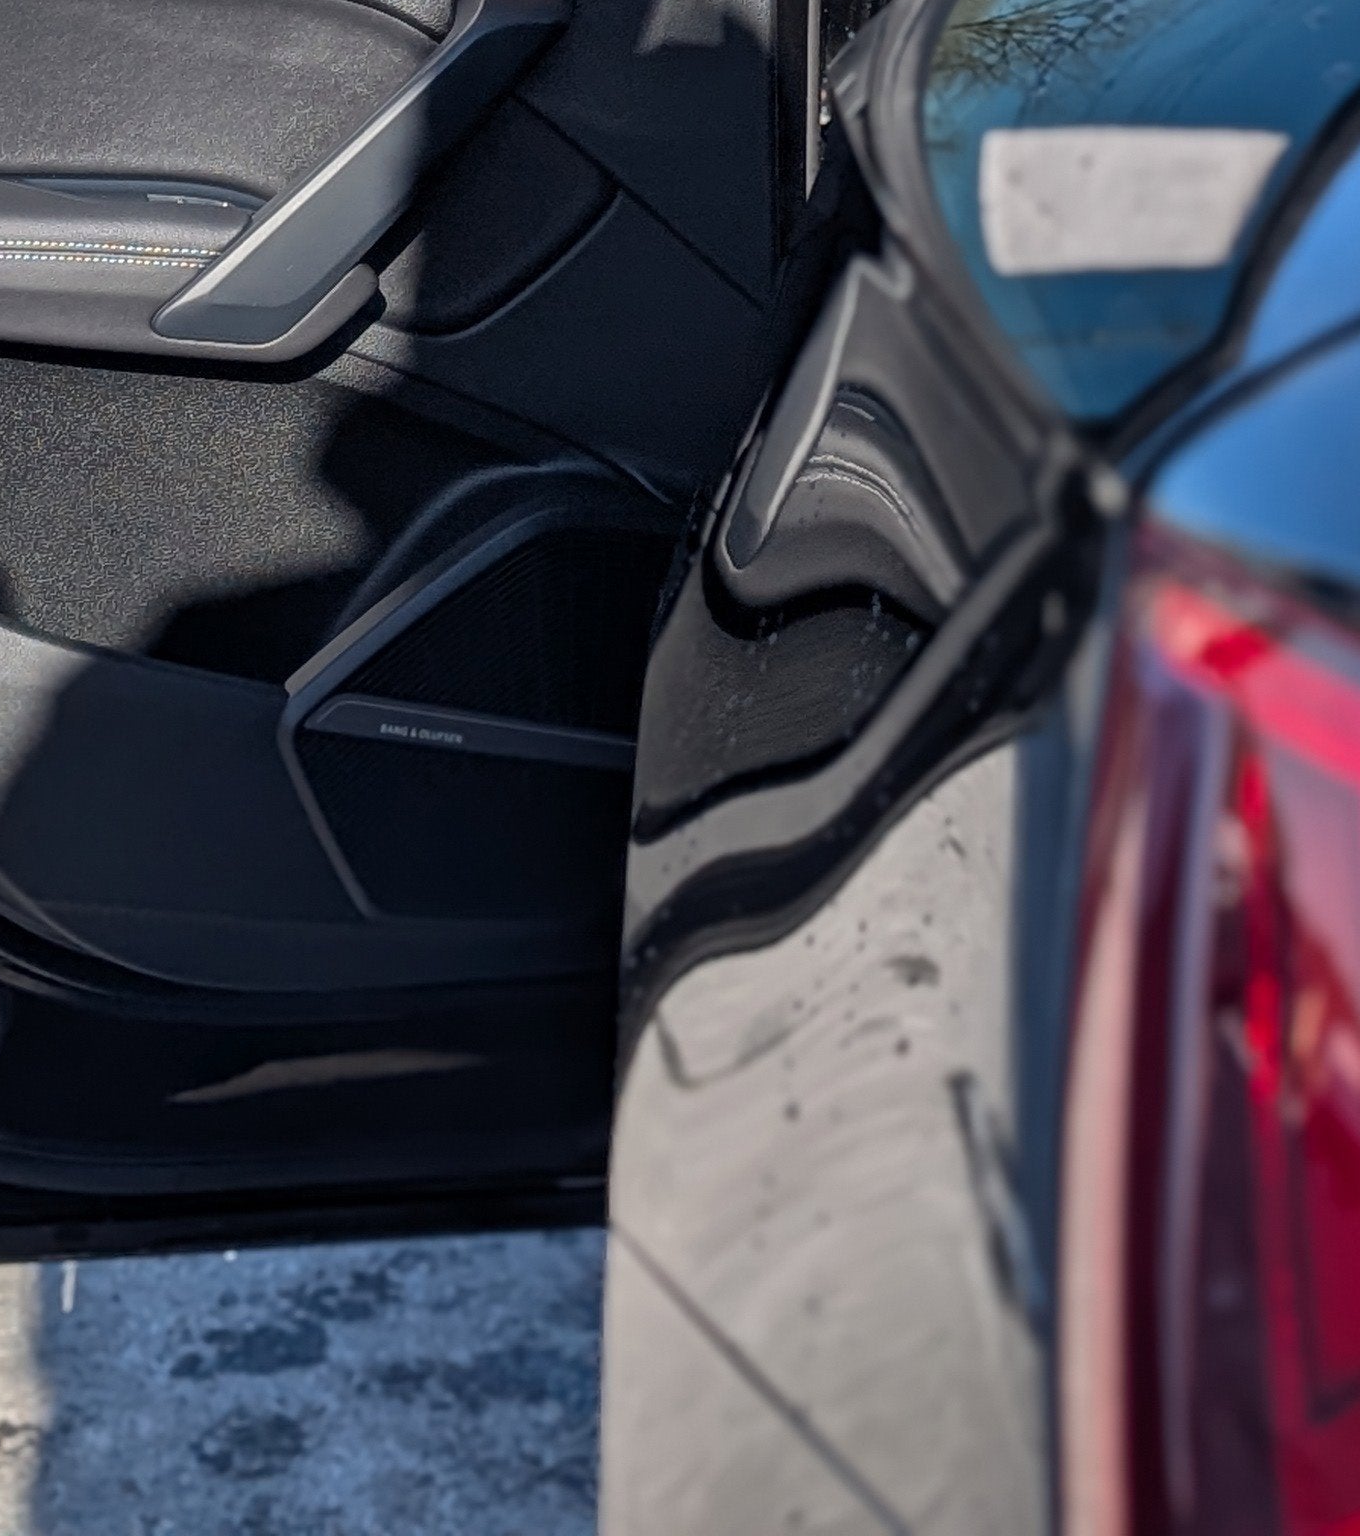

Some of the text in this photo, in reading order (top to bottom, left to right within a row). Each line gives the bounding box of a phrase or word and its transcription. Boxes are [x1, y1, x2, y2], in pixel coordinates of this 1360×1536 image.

[380, 724, 463, 744] BANG & OLUFSEN
